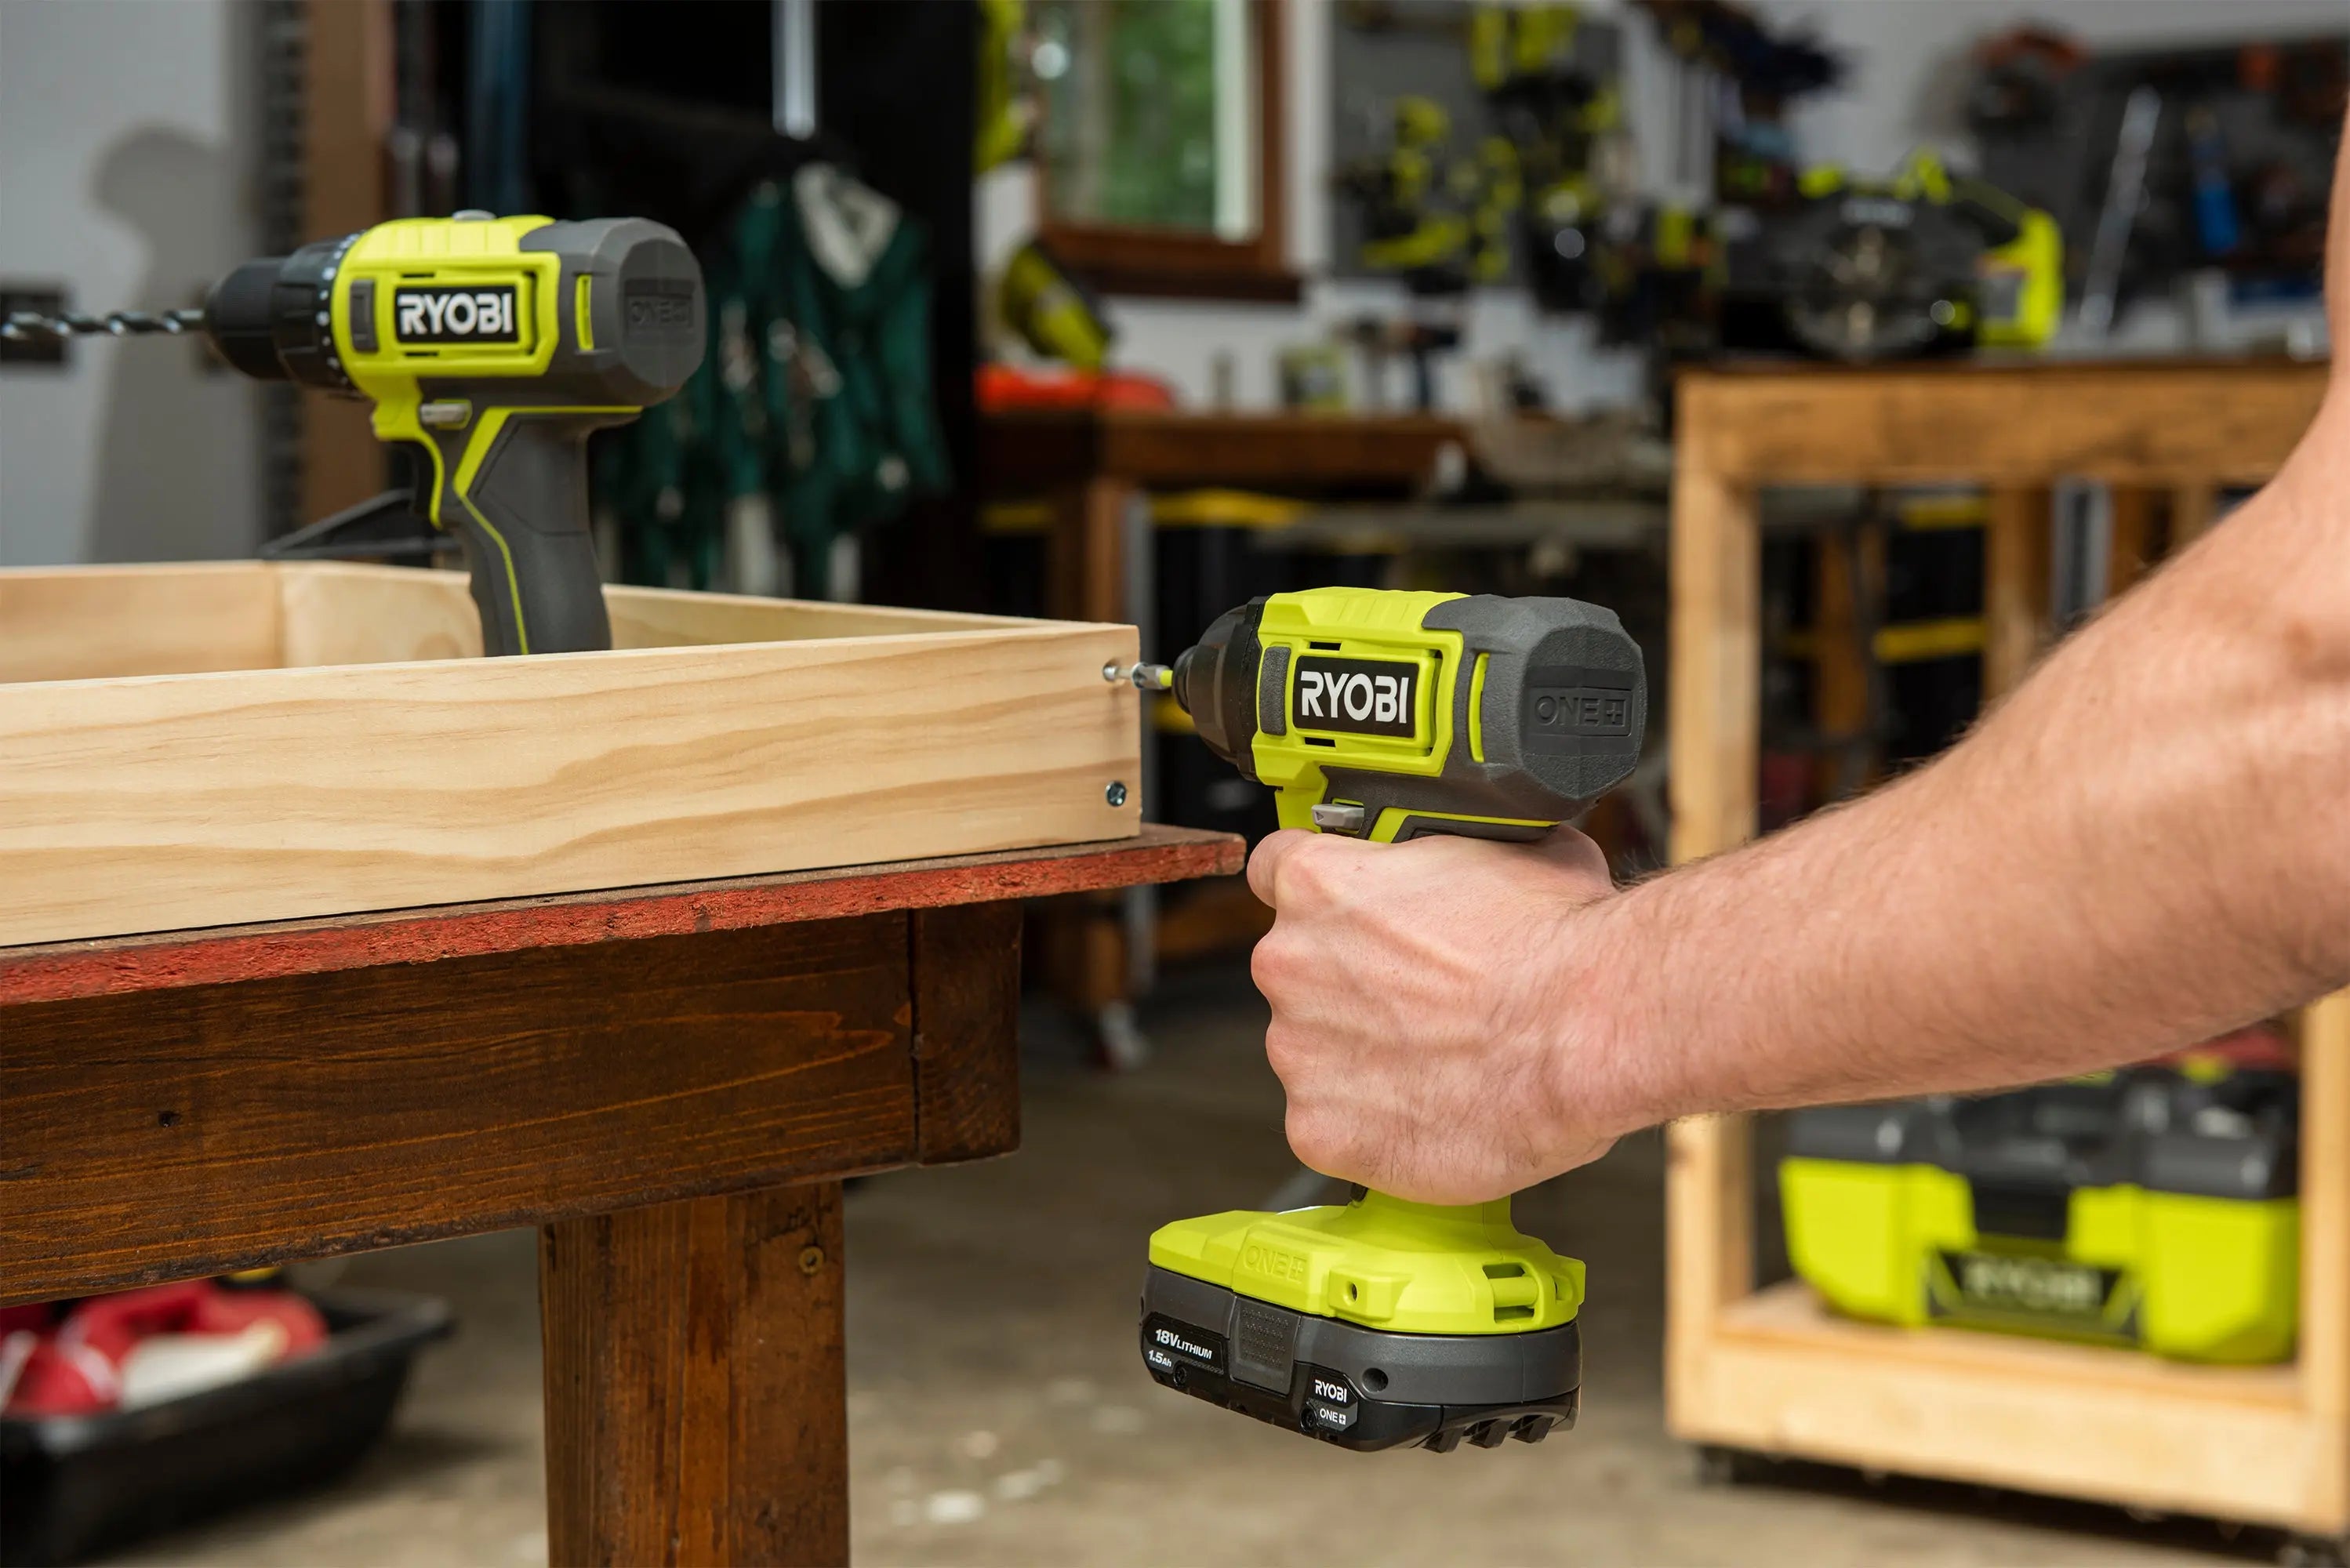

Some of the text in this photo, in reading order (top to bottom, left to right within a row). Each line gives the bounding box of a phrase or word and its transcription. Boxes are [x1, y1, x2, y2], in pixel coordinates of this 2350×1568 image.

[398, 292, 514, 335] RYOBI
[1300, 670, 1410, 724] RYOBI
[1148, 1349, 1172, 1367] 1.5Ah
[1315, 1379, 1347, 1403] RYOBI
